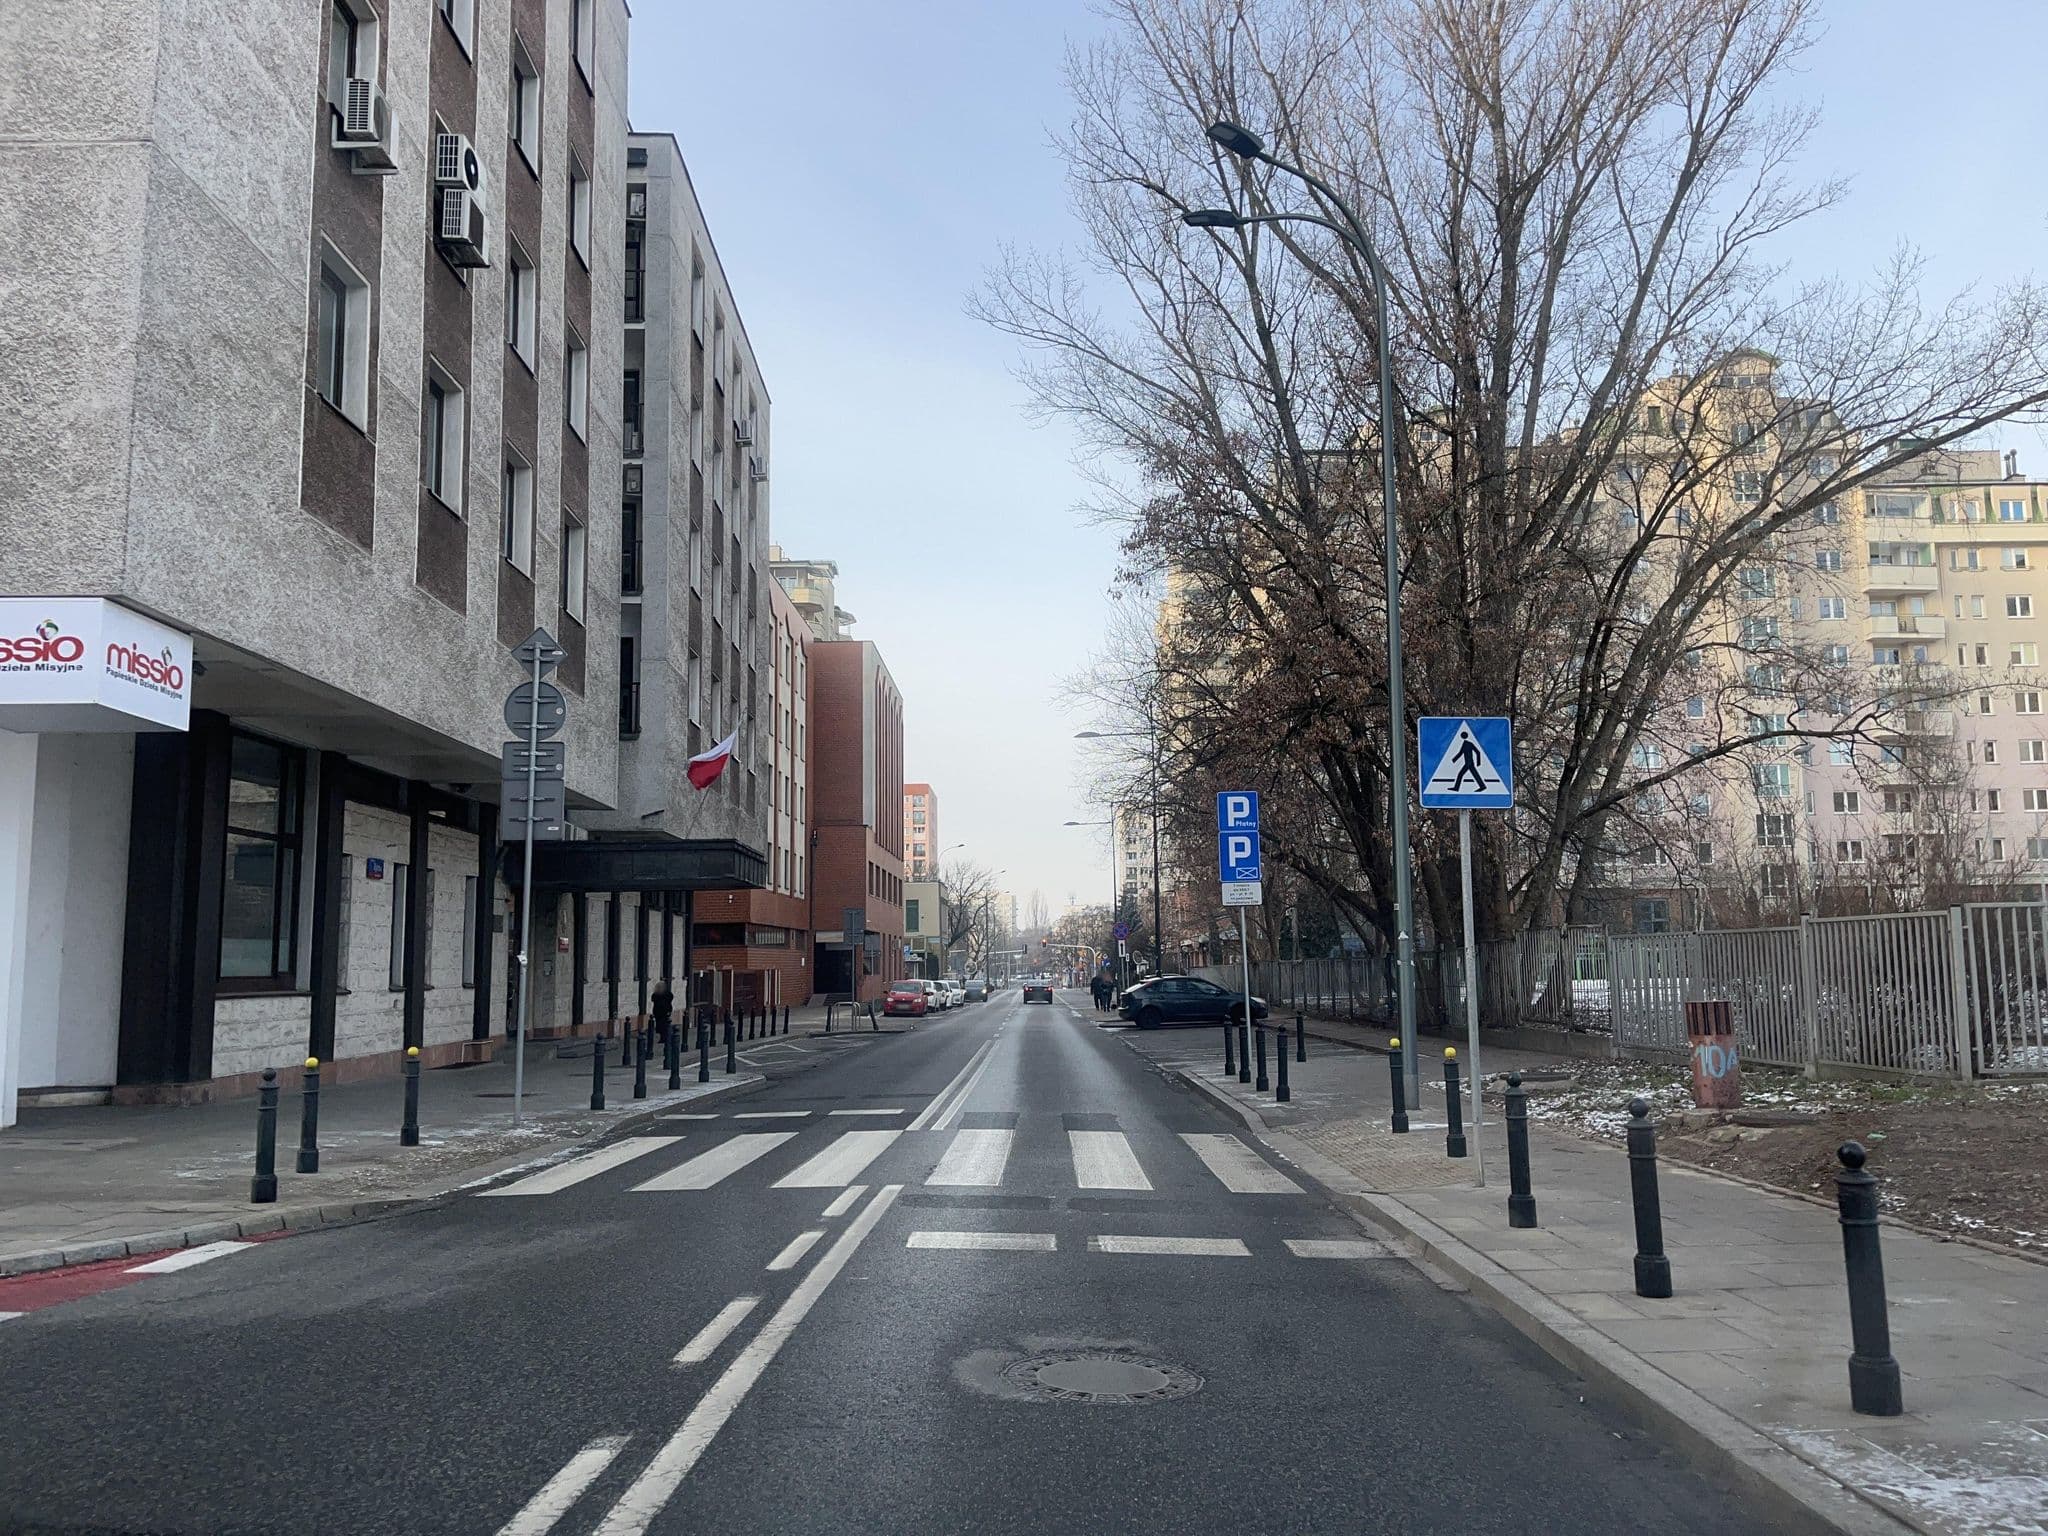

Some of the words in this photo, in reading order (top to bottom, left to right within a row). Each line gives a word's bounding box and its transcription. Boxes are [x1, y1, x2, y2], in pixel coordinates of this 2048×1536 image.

[0, 663, 31, 672] zieła
[35, 663, 83, 673] Misyjne
[106, 642, 184, 690] missio
[106, 666, 138, 684] Papieskie
[160, 685, 183, 700] Misyjne
[1227, 796, 1250, 827] P
[1228, 836, 1252, 868] P
